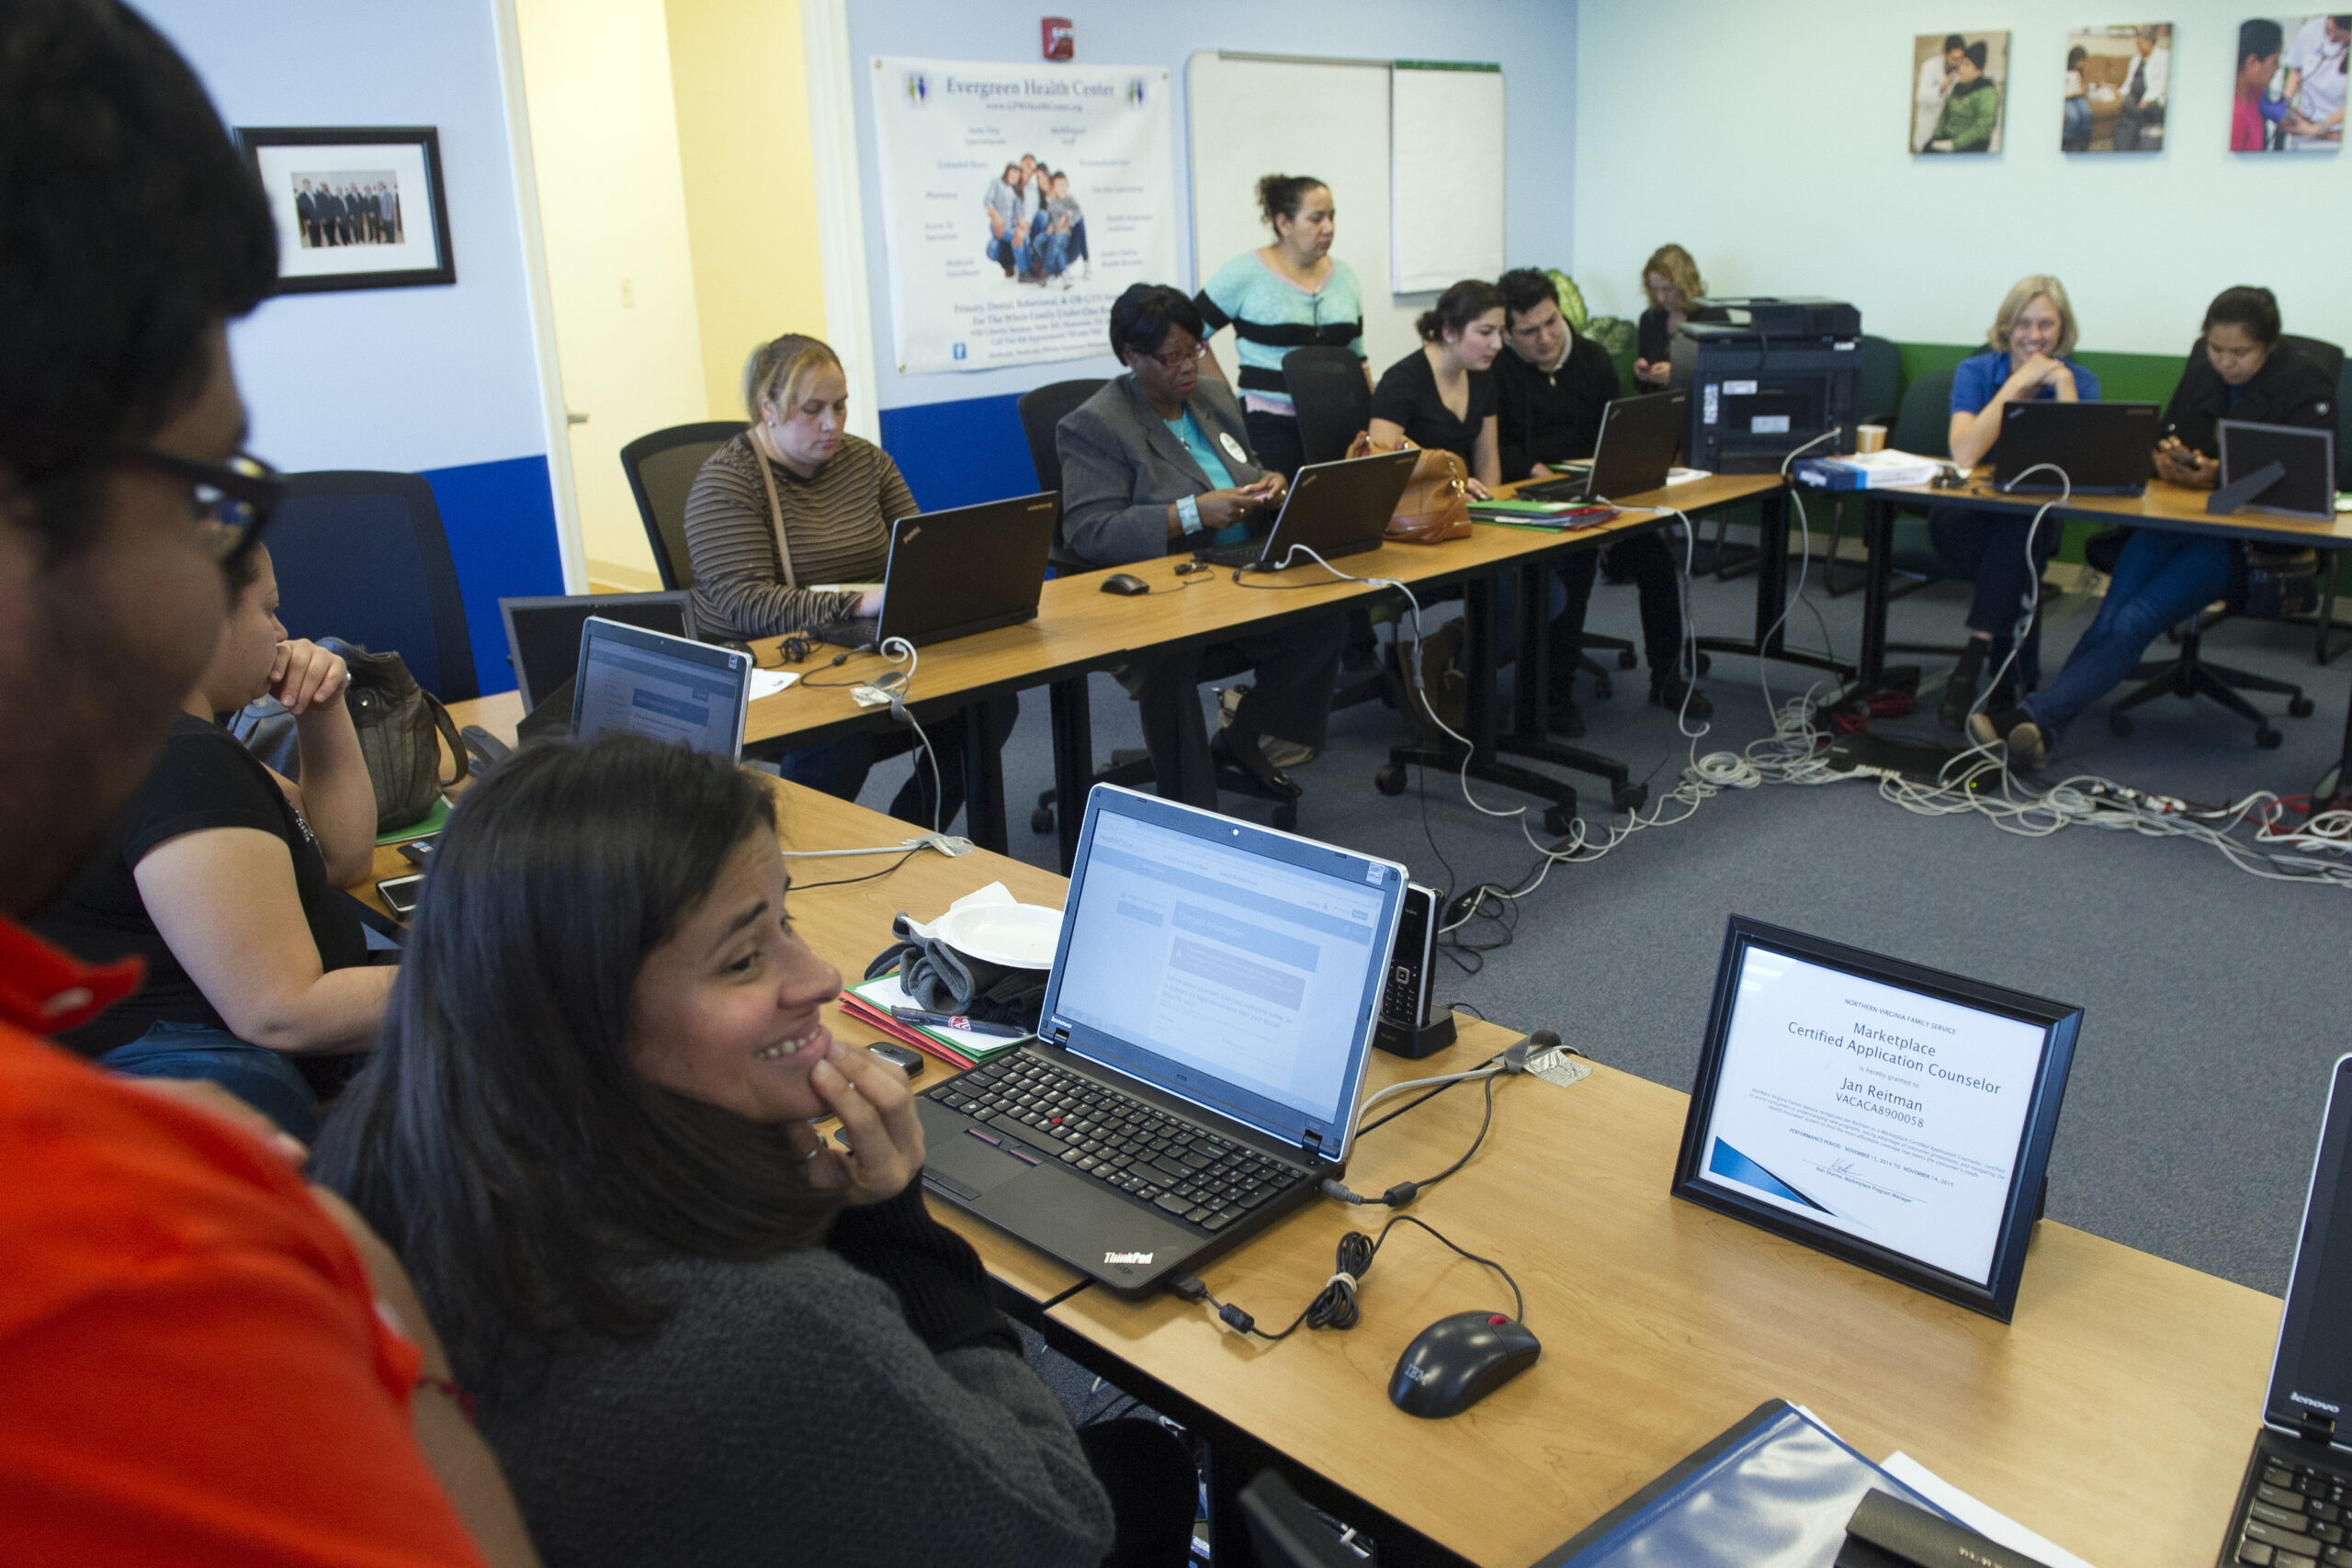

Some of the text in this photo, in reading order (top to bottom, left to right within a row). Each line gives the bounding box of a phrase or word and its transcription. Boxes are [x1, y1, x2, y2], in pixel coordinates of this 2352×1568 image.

[946, 76, 1114, 99] Evergreen Health Center
[1051, 1015, 1072, 1029] lenovo
[1844, 998, 1956, 1035] NORTHERN VIRGINIA FAMILY SERVICE
[1851, 1021, 1937, 1059] Marketplace
[1787, 1021, 2002, 1096] Certified Application Counselor
[1864, 1066, 1886, 1079] hereby
[1887, 1073, 1911, 1087] granted
[1839, 1076, 1923, 1112] Jan Reitman
[1834, 1091, 1925, 1128] VACACA8900058
[1789, 1127, 1823, 1143] PERFORMANCE
[1844, 1146, 1870, 1158] NOVEMBER
[1879, 1158, 1893, 1167] 2014
[1902, 1166, 1929, 1179] NOVEMBER
[1844, 1176, 1871, 1190] Marketplace
[1871, 1186, 1891, 1197] Program
[1891, 1193, 1911, 1204] Manager
[1103, 1250, 1154, 1265] ThinkPad
[1405, 1363, 1430, 1386] IBM
[2290, 1391, 2340, 1413] lenovo
